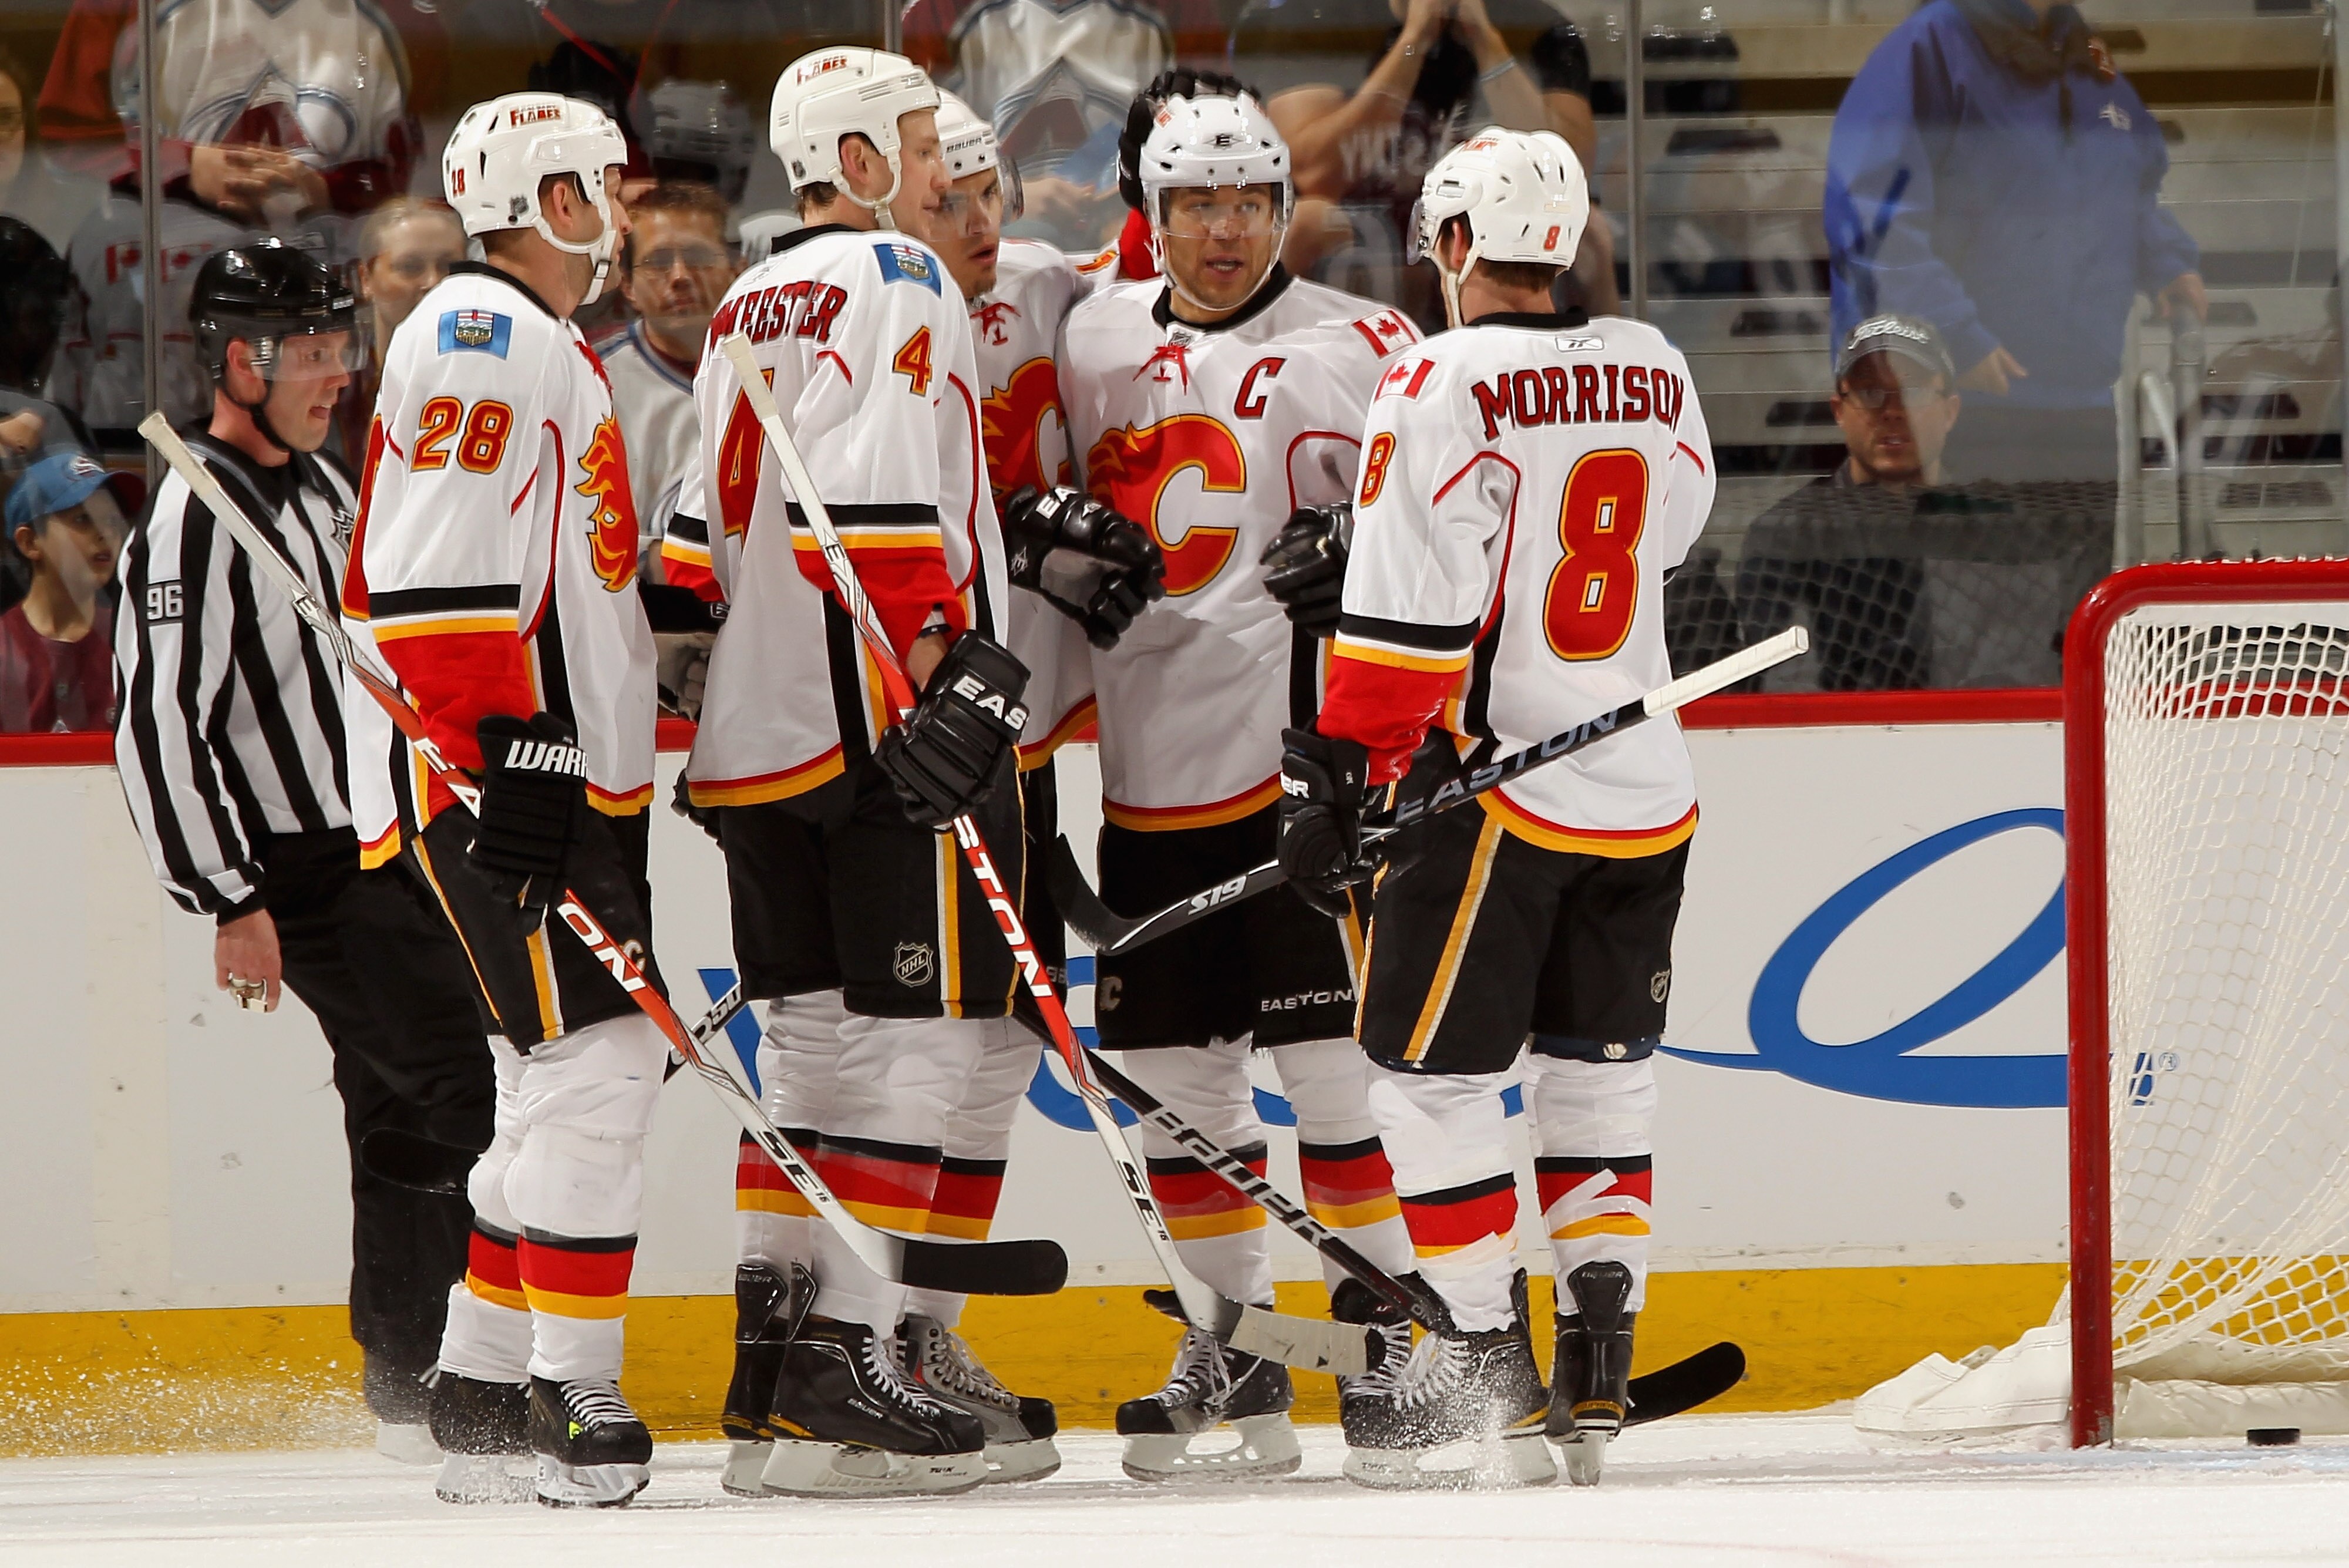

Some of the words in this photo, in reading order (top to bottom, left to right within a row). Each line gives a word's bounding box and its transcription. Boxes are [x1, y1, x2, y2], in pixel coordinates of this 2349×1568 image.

[510, 108, 561, 128] FLAMES
[947, 137, 982, 153] BAUER
[452, 168, 465, 197] 28
[1544, 226, 1561, 251] 8
[893, 325, 933, 397] 4
[1233, 357, 1286, 419] C
[1471, 364, 1684, 442] MORRISON
[410, 396, 514, 475] 28
[1358, 432, 1396, 508] 8
[1086, 413, 1247, 597] C
[1543, 447, 1650, 661] 8
[147, 584, 183, 621] 96
[952, 675, 1028, 731] EAS
[1393, 709, 1619, 824] EASTON
[952, 815, 1054, 998] STON
[1187, 875, 1247, 917] S19
[901, 955, 926, 976] NHL
[1261, 988, 1353, 1012] EASTON
[1145, 1106, 1335, 1249] BAUER
